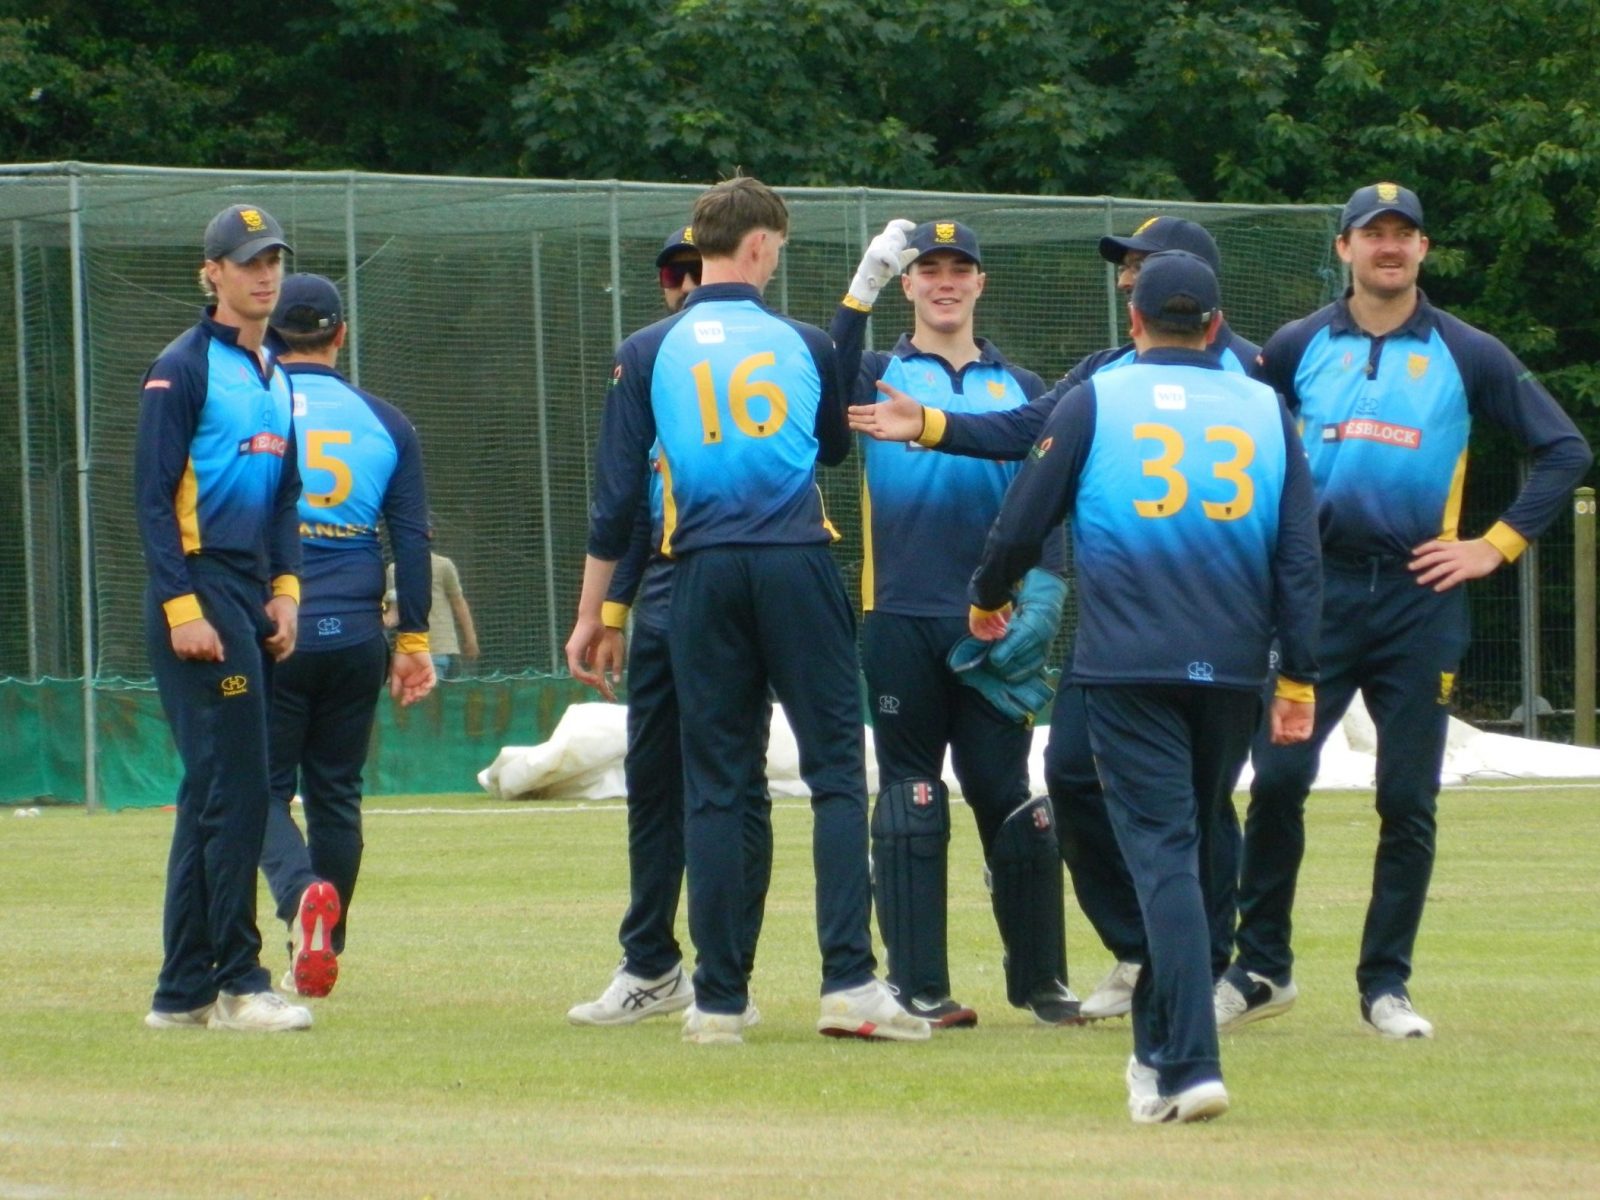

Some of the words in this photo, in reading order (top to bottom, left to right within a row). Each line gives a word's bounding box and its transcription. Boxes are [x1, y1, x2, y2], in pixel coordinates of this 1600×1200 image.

[691, 351, 788, 445] 16
[305, 429, 353, 509] 5
[1132, 423, 1256, 522] 33
